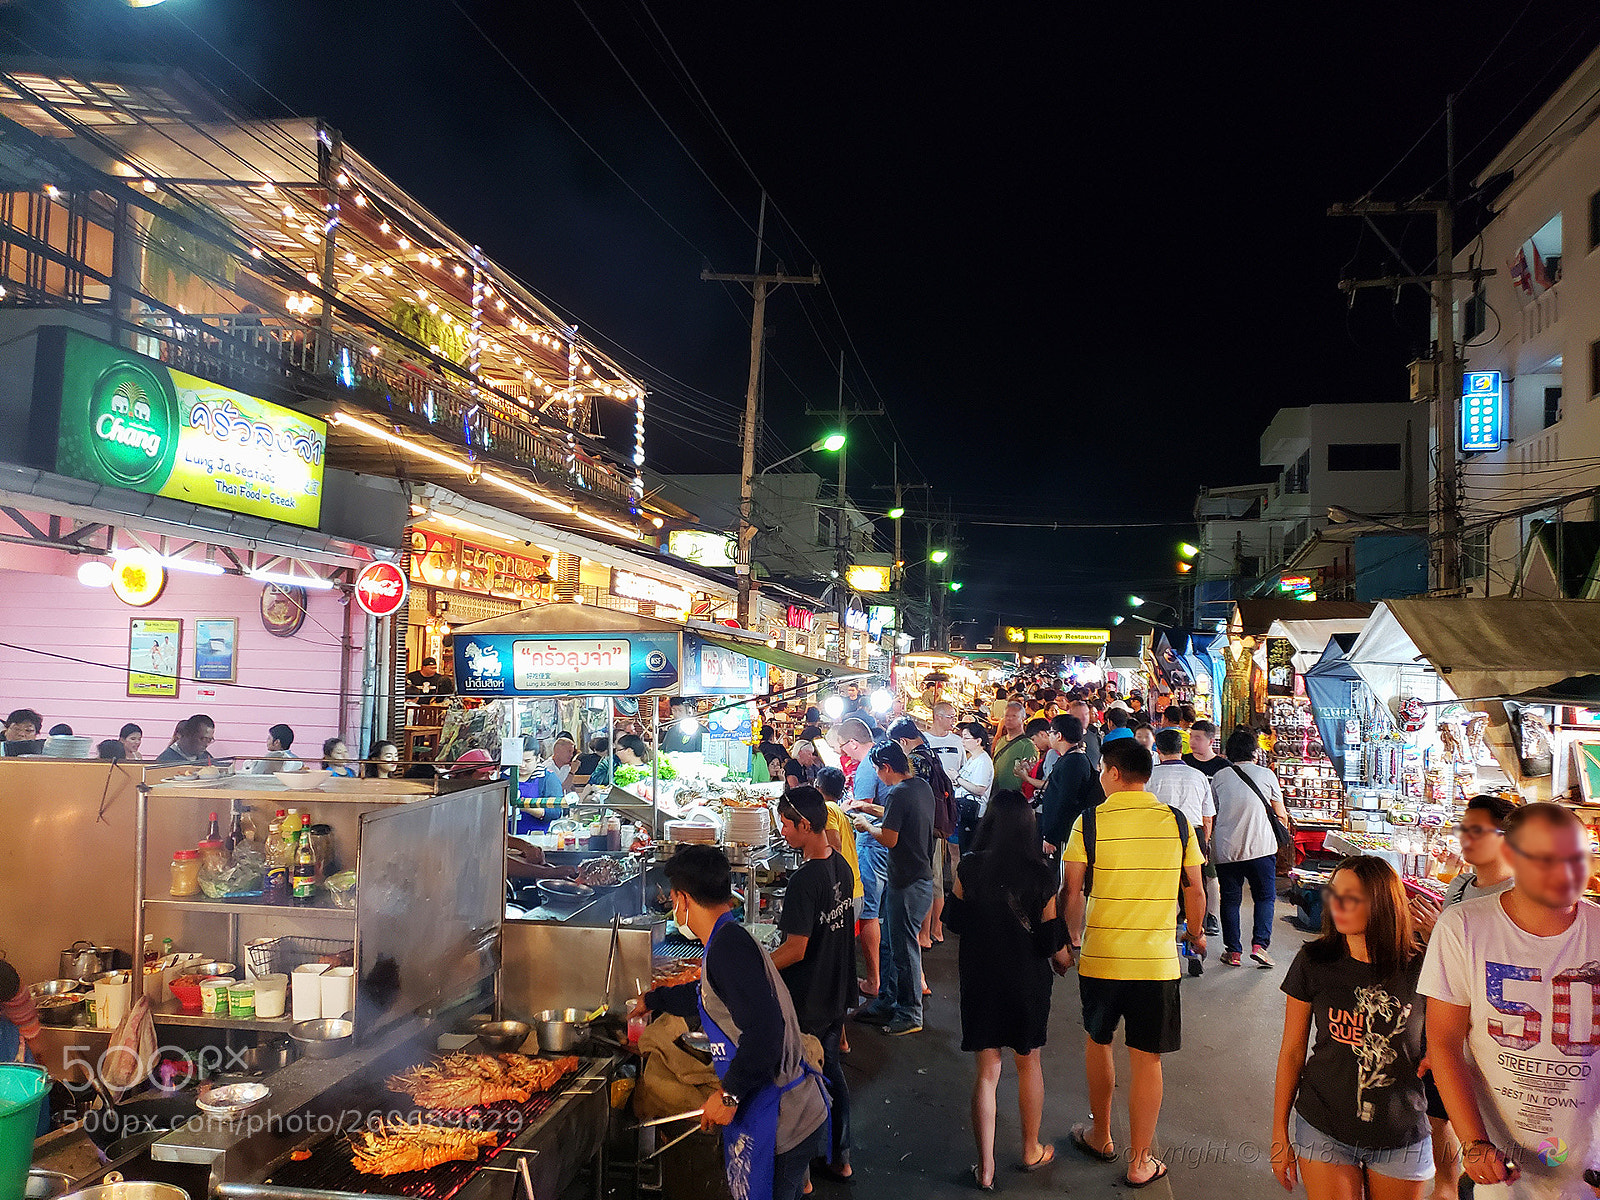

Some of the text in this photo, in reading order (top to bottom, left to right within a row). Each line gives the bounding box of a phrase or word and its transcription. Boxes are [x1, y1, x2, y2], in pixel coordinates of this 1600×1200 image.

[96, 413, 161, 457] Chang
[185, 450, 214, 475] Lung
[217, 458, 231, 473] Ja
[215, 479, 238, 496] Thai
[239, 485, 262, 502] Food
[269, 492, 297, 509] Steak
[1033, 633, 1063, 641] Railway
[1329, 1007, 1364, 1027] UNI
[1485, 960, 1600, 1056] 50
[1329, 1022, 1364, 1042] QUE
[1497, 1053, 1592, 1077] STREET FOOD
[1527, 1094, 1539, 1103] IN
